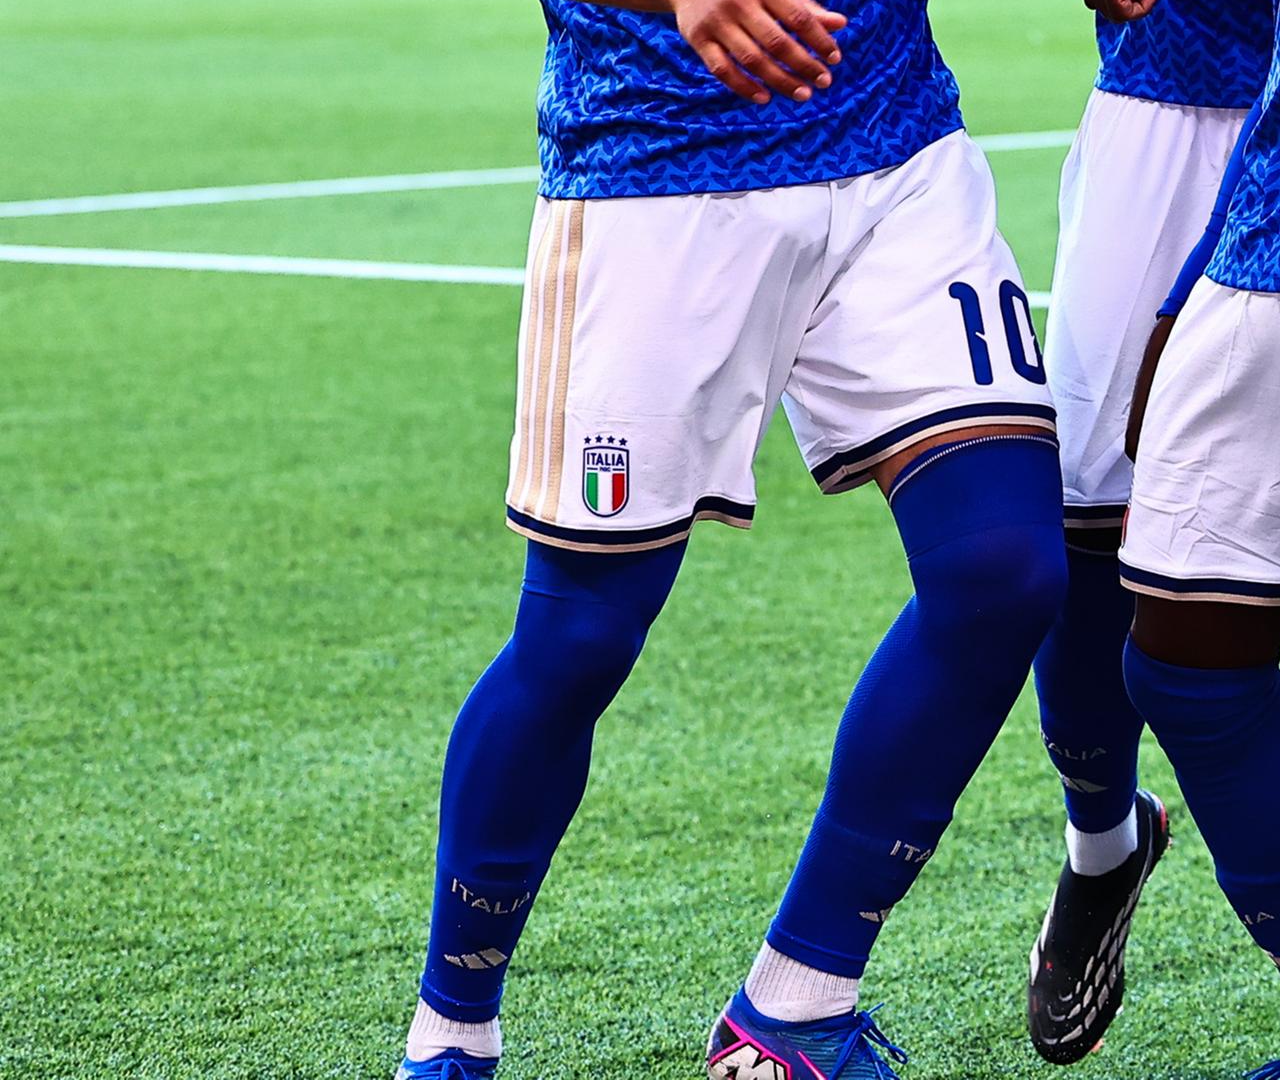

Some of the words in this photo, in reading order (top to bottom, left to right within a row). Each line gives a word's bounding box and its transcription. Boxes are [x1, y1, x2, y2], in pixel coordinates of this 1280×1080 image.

[948, 279, 1047, 385] 10
[586, 452, 625, 466] ITALIA
[890, 840, 932, 863] ITA
